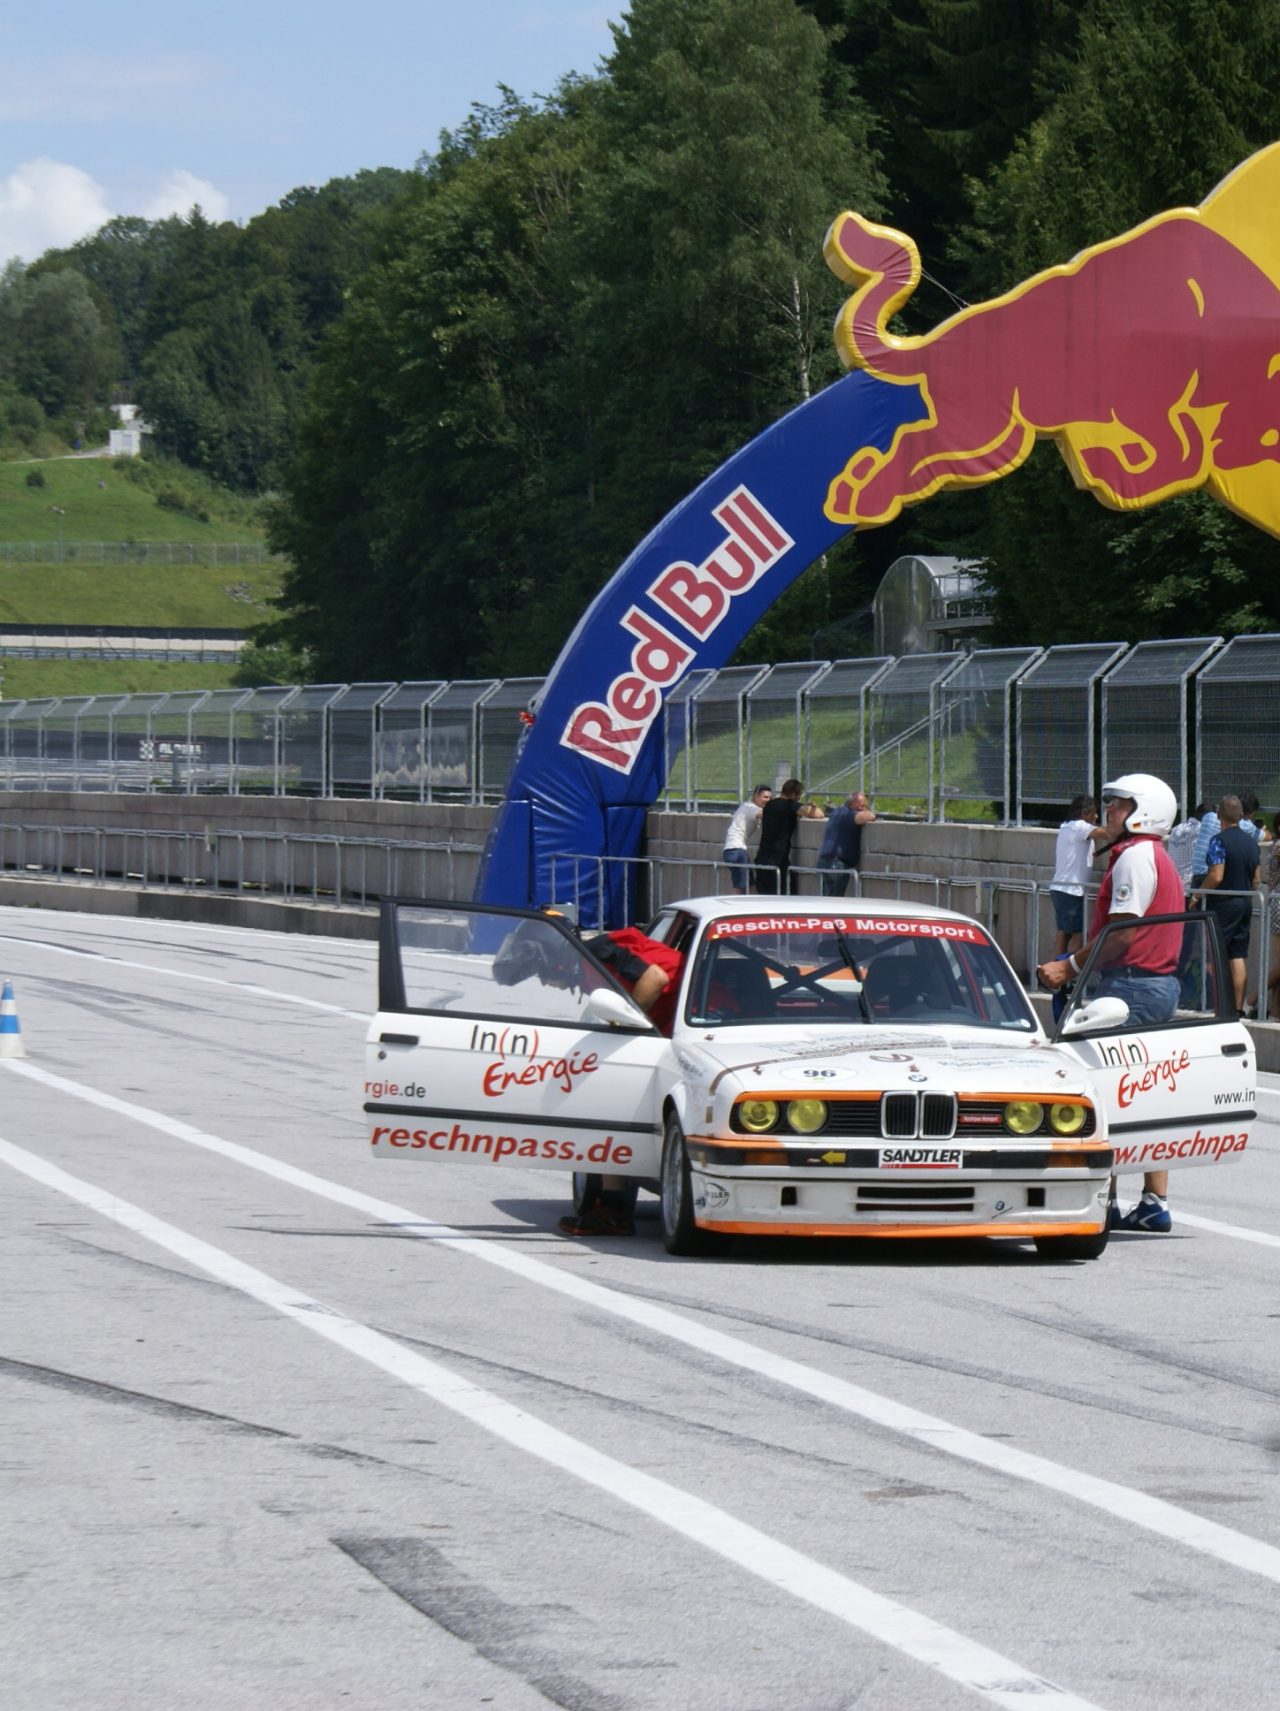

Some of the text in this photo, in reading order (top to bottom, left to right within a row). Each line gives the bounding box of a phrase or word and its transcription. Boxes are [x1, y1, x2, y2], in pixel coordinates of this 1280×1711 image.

[562, 486, 793, 773] Red Bull
[855, 919, 976, 940] Motorsport
[470, 1024, 540, 1061] In(n)
[1097, 1037, 1149, 1070] In(n)
[364, 1079, 427, 1099] rgie.de
[483, 1050, 599, 1098] Energie
[803, 1069, 837, 1078] 96
[1117, 1049, 1191, 1109] Energie
[1213, 1087, 1256, 1105] www.in
[371, 1124, 634, 1165] reschnpass.de
[882, 1149, 961, 1163] SANDTLER
